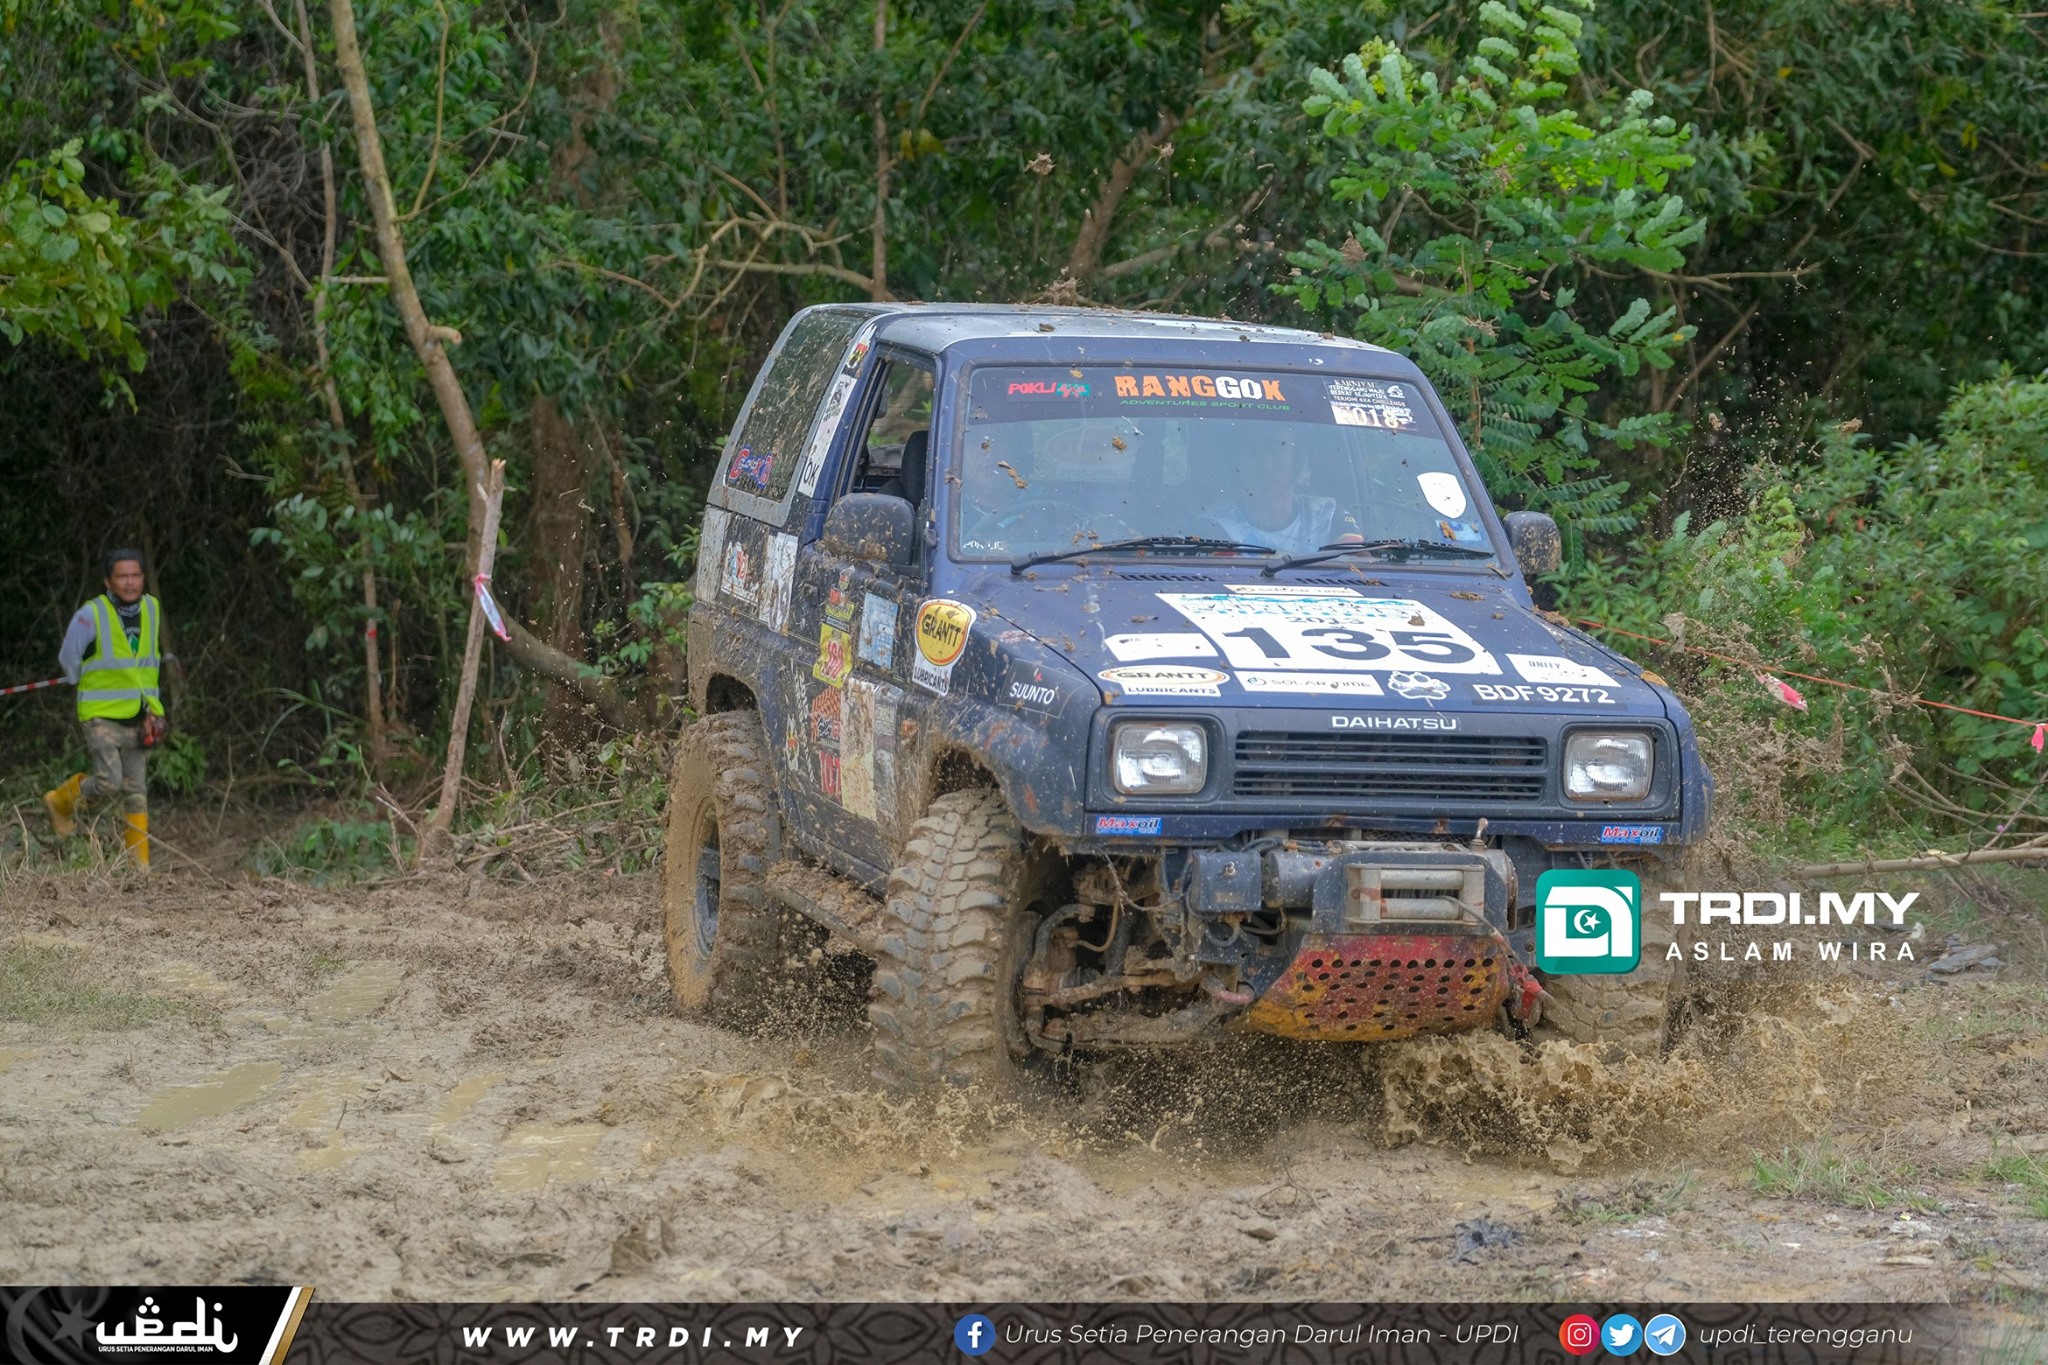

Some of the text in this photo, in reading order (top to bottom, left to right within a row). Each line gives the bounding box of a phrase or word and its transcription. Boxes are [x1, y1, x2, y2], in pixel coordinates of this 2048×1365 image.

[1008, 381, 1056, 395] POKLI
[1114, 375, 1286, 402] RANGGOK
[1120, 399, 1291, 411] ADVENTURES SPORT CLUB
[921, 613, 961, 648] GRANTT
[1221, 626, 1476, 664] 135
[1528, 660, 1561, 670] UNITY
[914, 666, 948, 693] LUBRICANTS
[1116, 671, 1210, 681] GRANTT
[1271, 679, 1327, 687] SOLAR
[1009, 681, 1055, 705] SUUNTO
[1127, 686, 1217, 695] LUBRICANTS
[1472, 684, 1616, 704] BDF 9272
[1331, 716, 1458, 730] DAIHATSU
[1097, 816, 1160, 829] Maxoil
[1602, 826, 1660, 838] Maxoil
